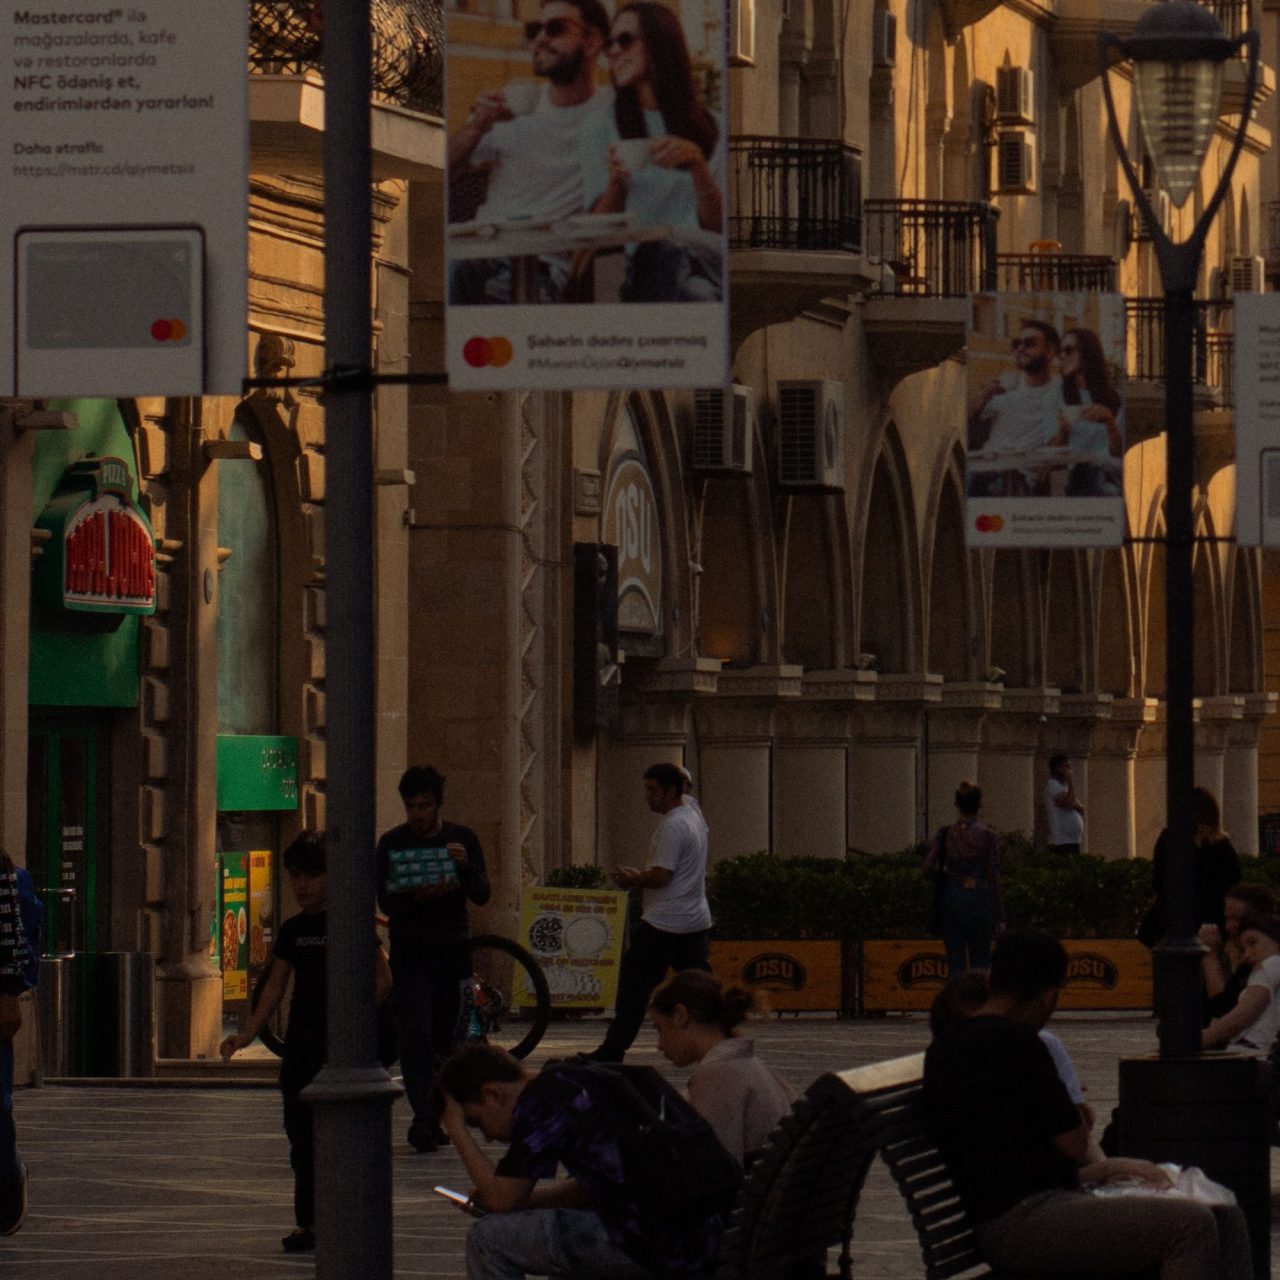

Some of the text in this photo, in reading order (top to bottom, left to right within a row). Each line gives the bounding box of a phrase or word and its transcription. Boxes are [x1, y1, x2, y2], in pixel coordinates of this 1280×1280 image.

[138, 29, 176, 45] kafe
[38, 53, 157, 68] restoranlarda
[14, 76, 52, 90] NFC
[135, 95, 214, 113] yararlan!
[13, 142, 51, 155] Daha
[102, 463, 127, 486] PIZZA
